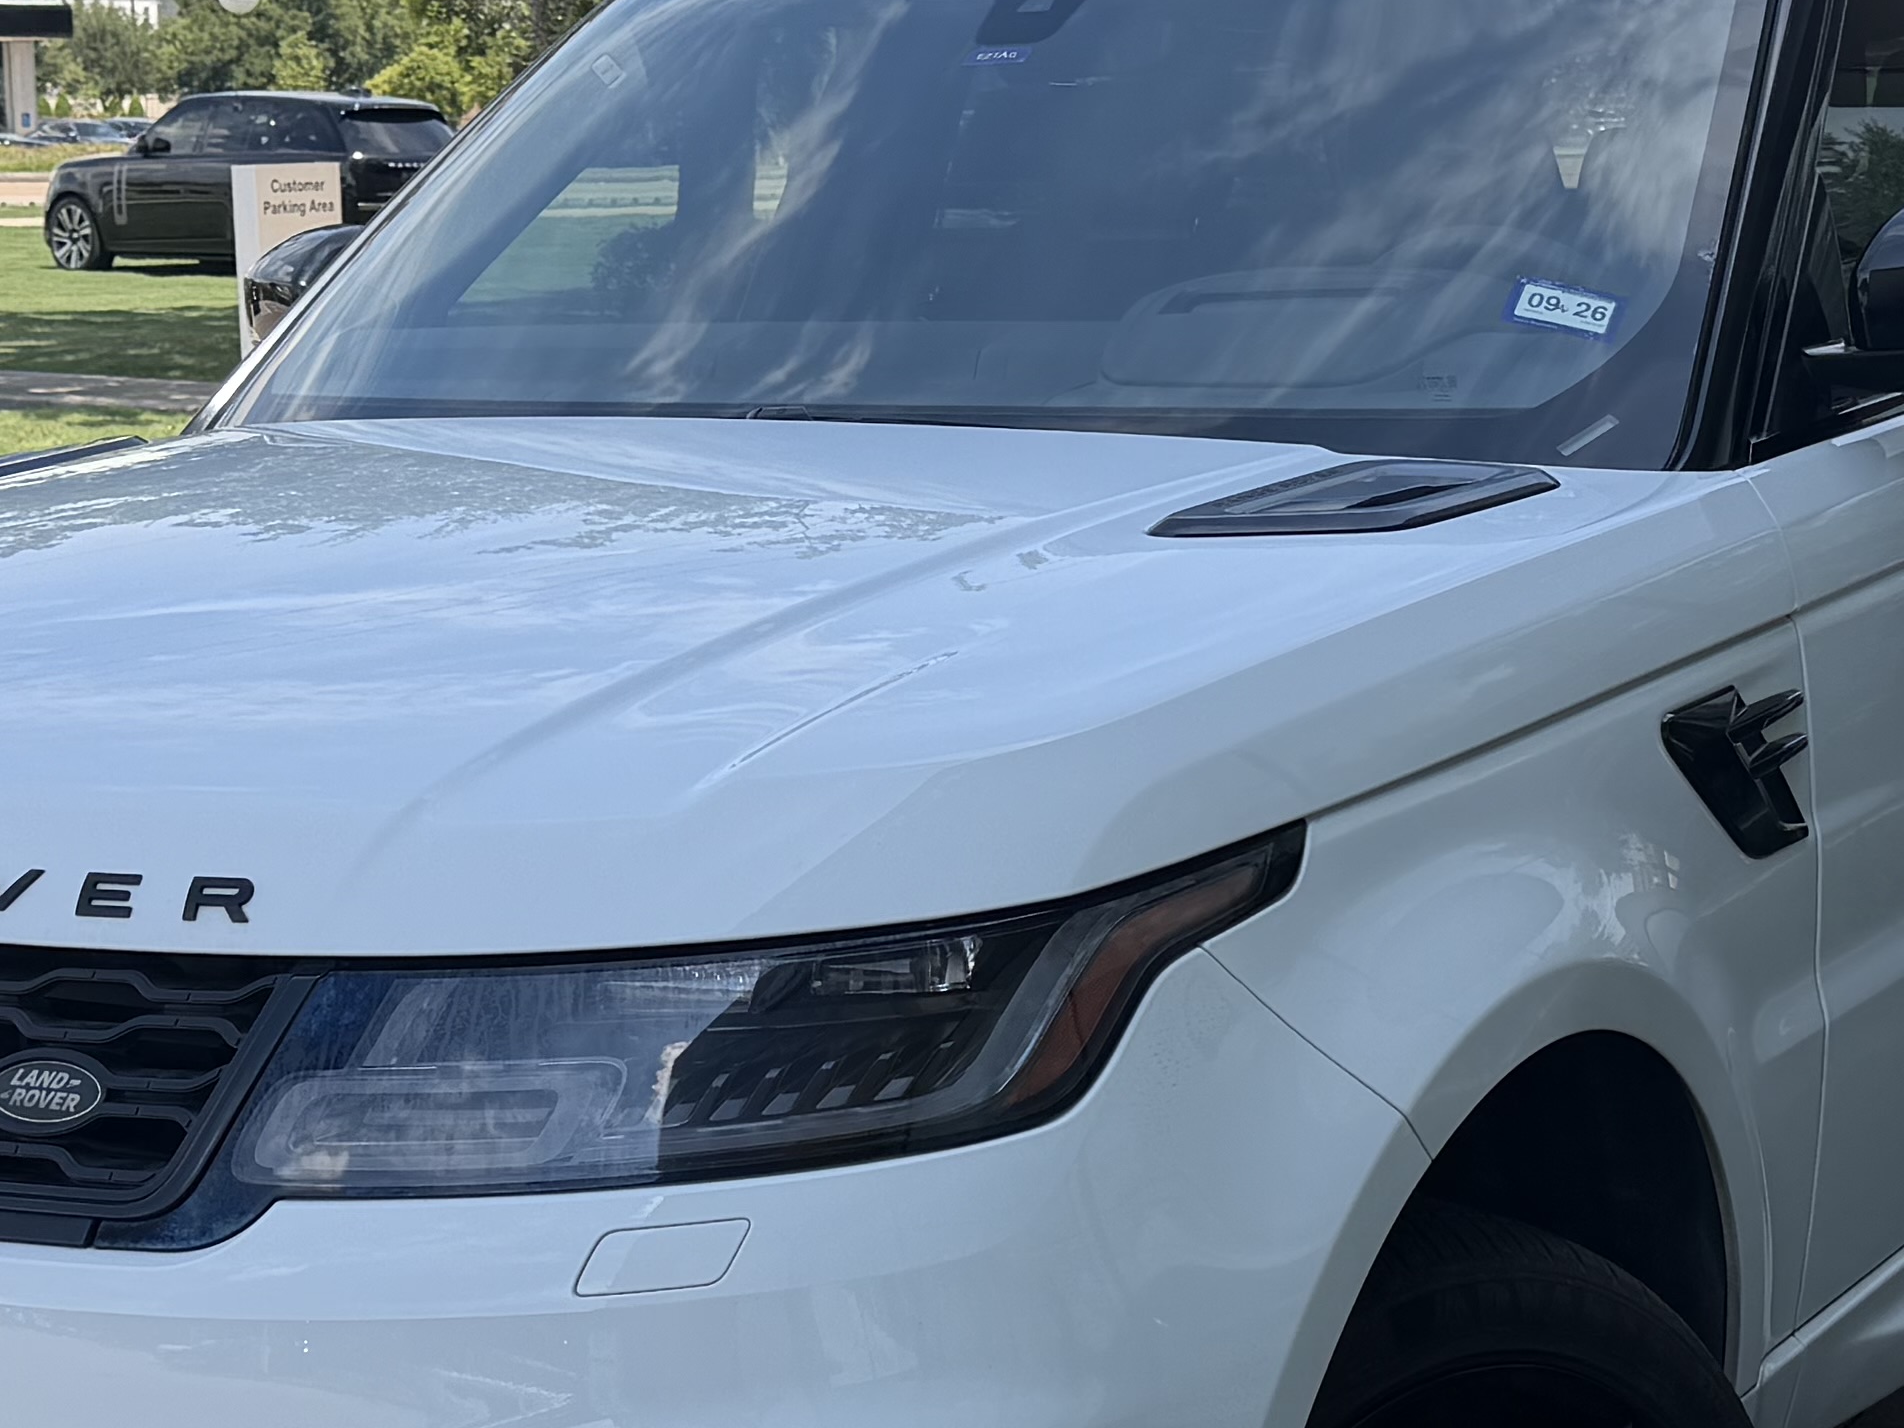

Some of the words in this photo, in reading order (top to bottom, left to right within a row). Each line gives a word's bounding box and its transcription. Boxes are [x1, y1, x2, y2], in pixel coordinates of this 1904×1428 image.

[270, 178, 326, 193] Customer
[263, 200, 307, 217] Parking
[309, 199, 335, 213] Area
[1572, 301, 1608, 322] 26
[10, 1068, 70, 1089] LAND
[9, 1087, 81, 1113] ROVER
